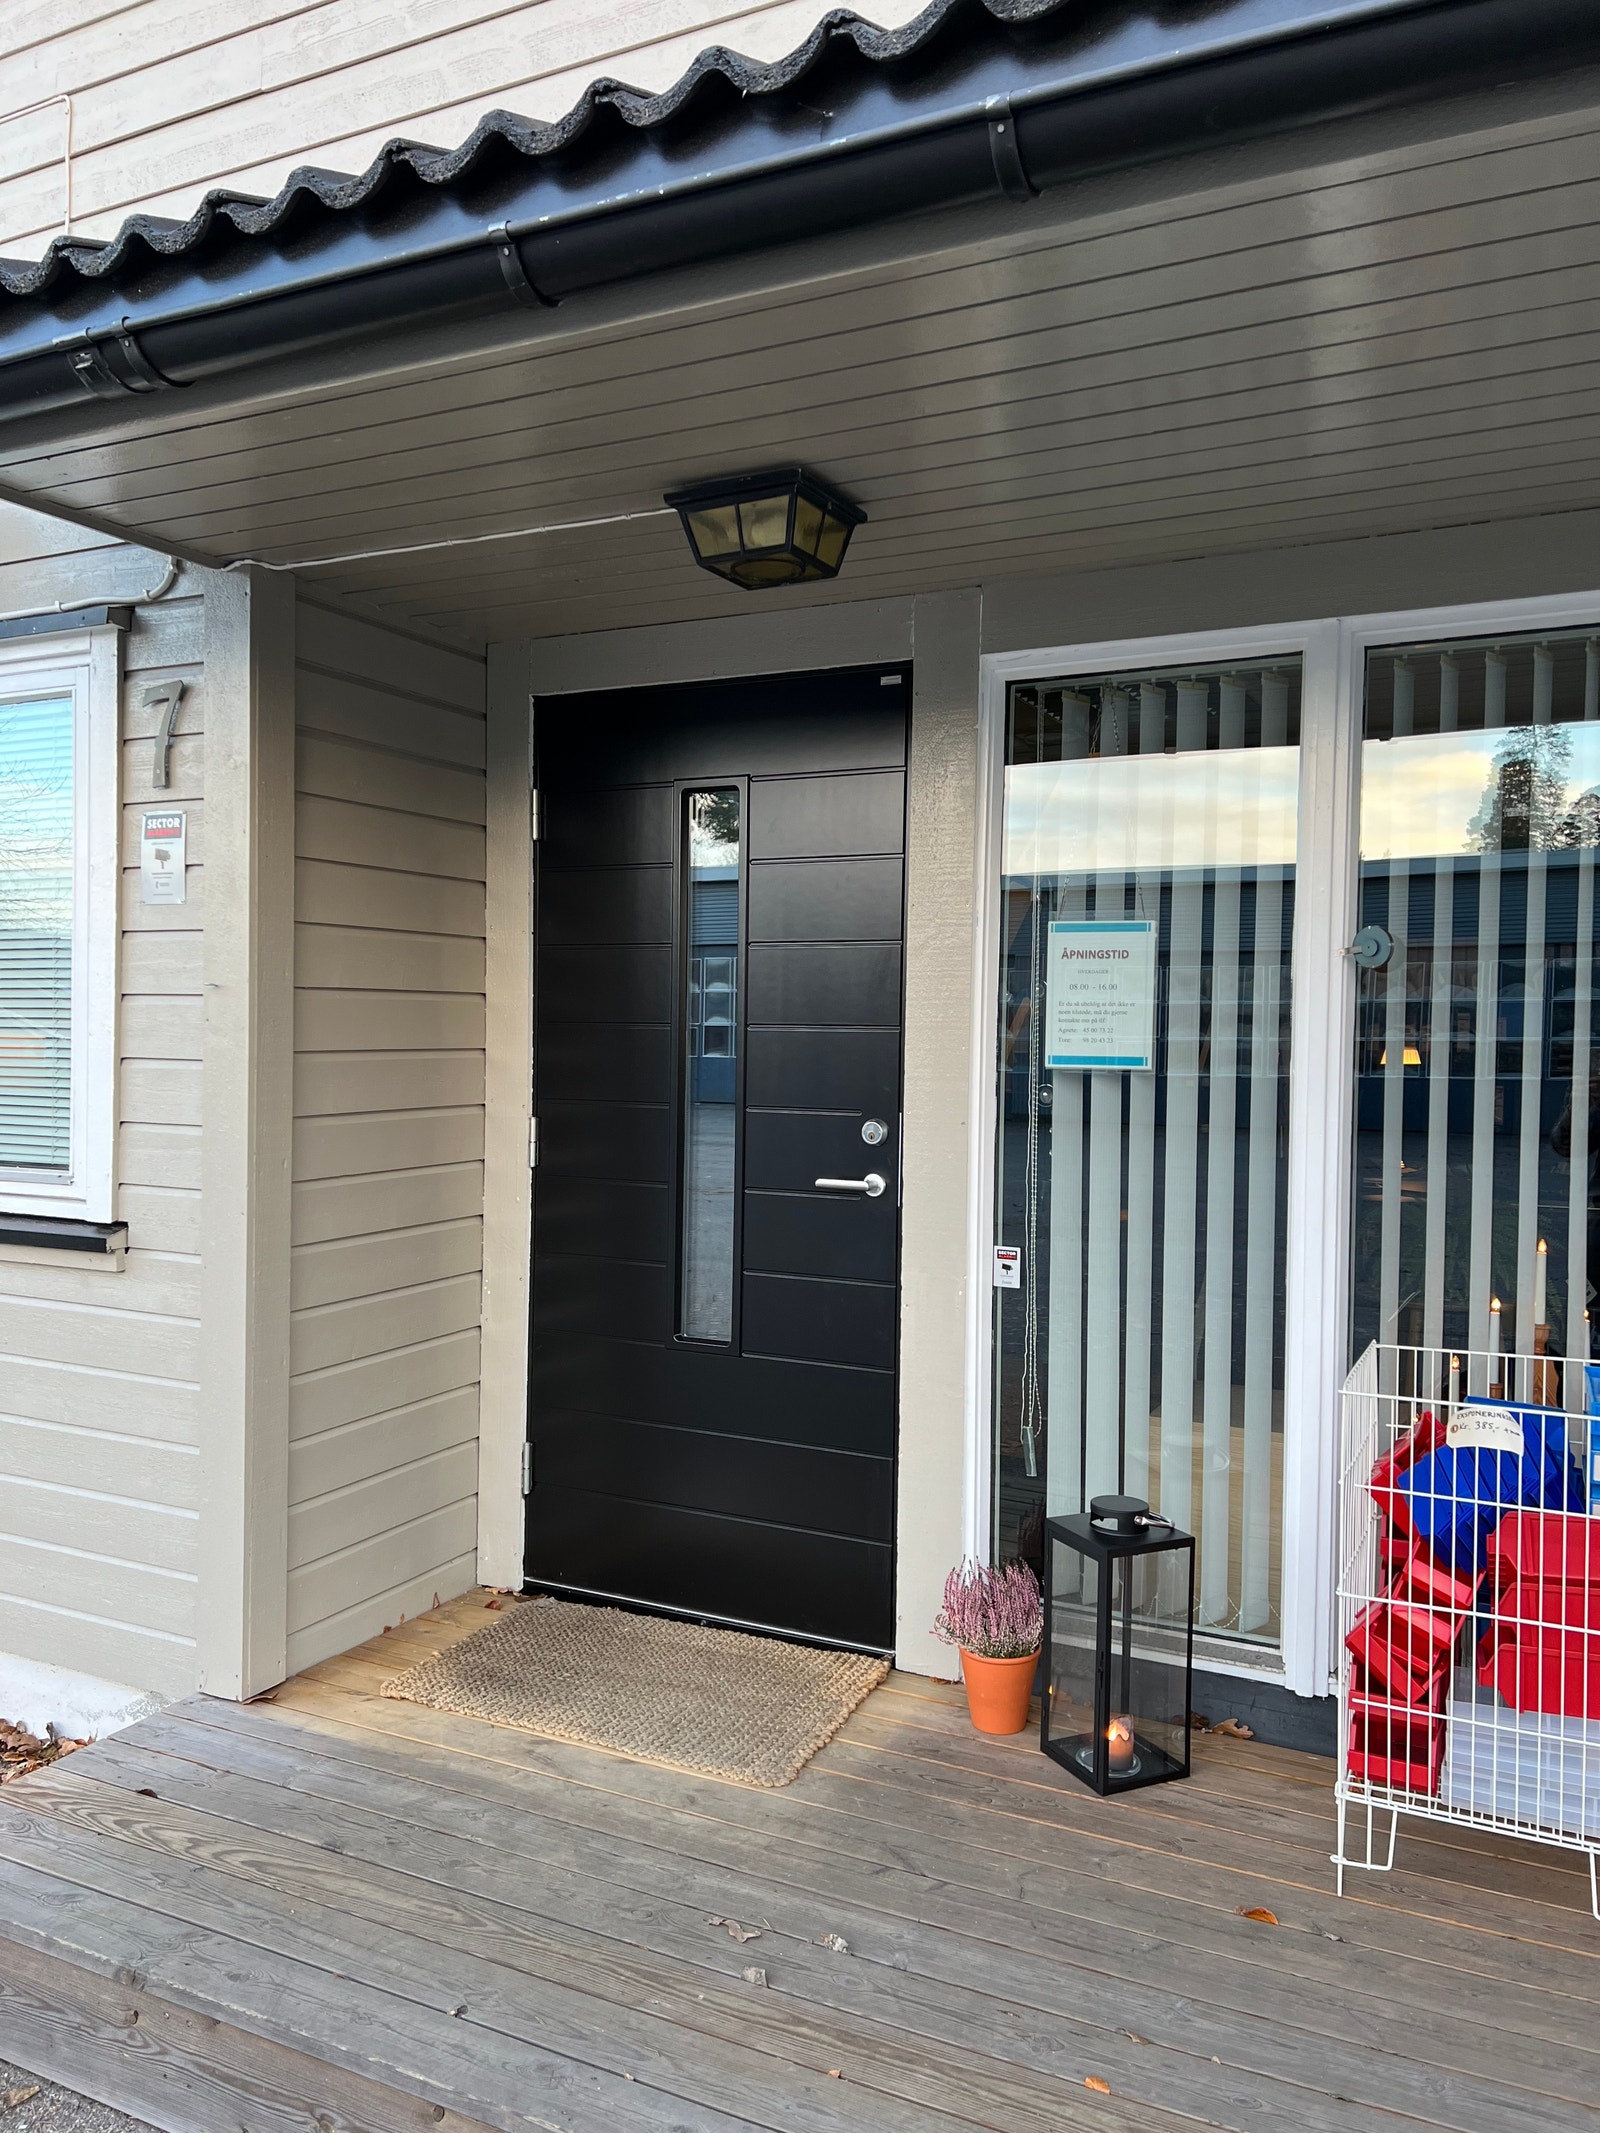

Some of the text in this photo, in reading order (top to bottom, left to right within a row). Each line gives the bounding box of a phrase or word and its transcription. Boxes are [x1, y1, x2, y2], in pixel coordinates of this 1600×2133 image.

[142, 679, 184, 789] 7
[146, 817, 180, 829] SECTOR
[1061, 947, 1130, 960] ÅPNINGSTID
[1098, 983, 1118, 991] 16.00
